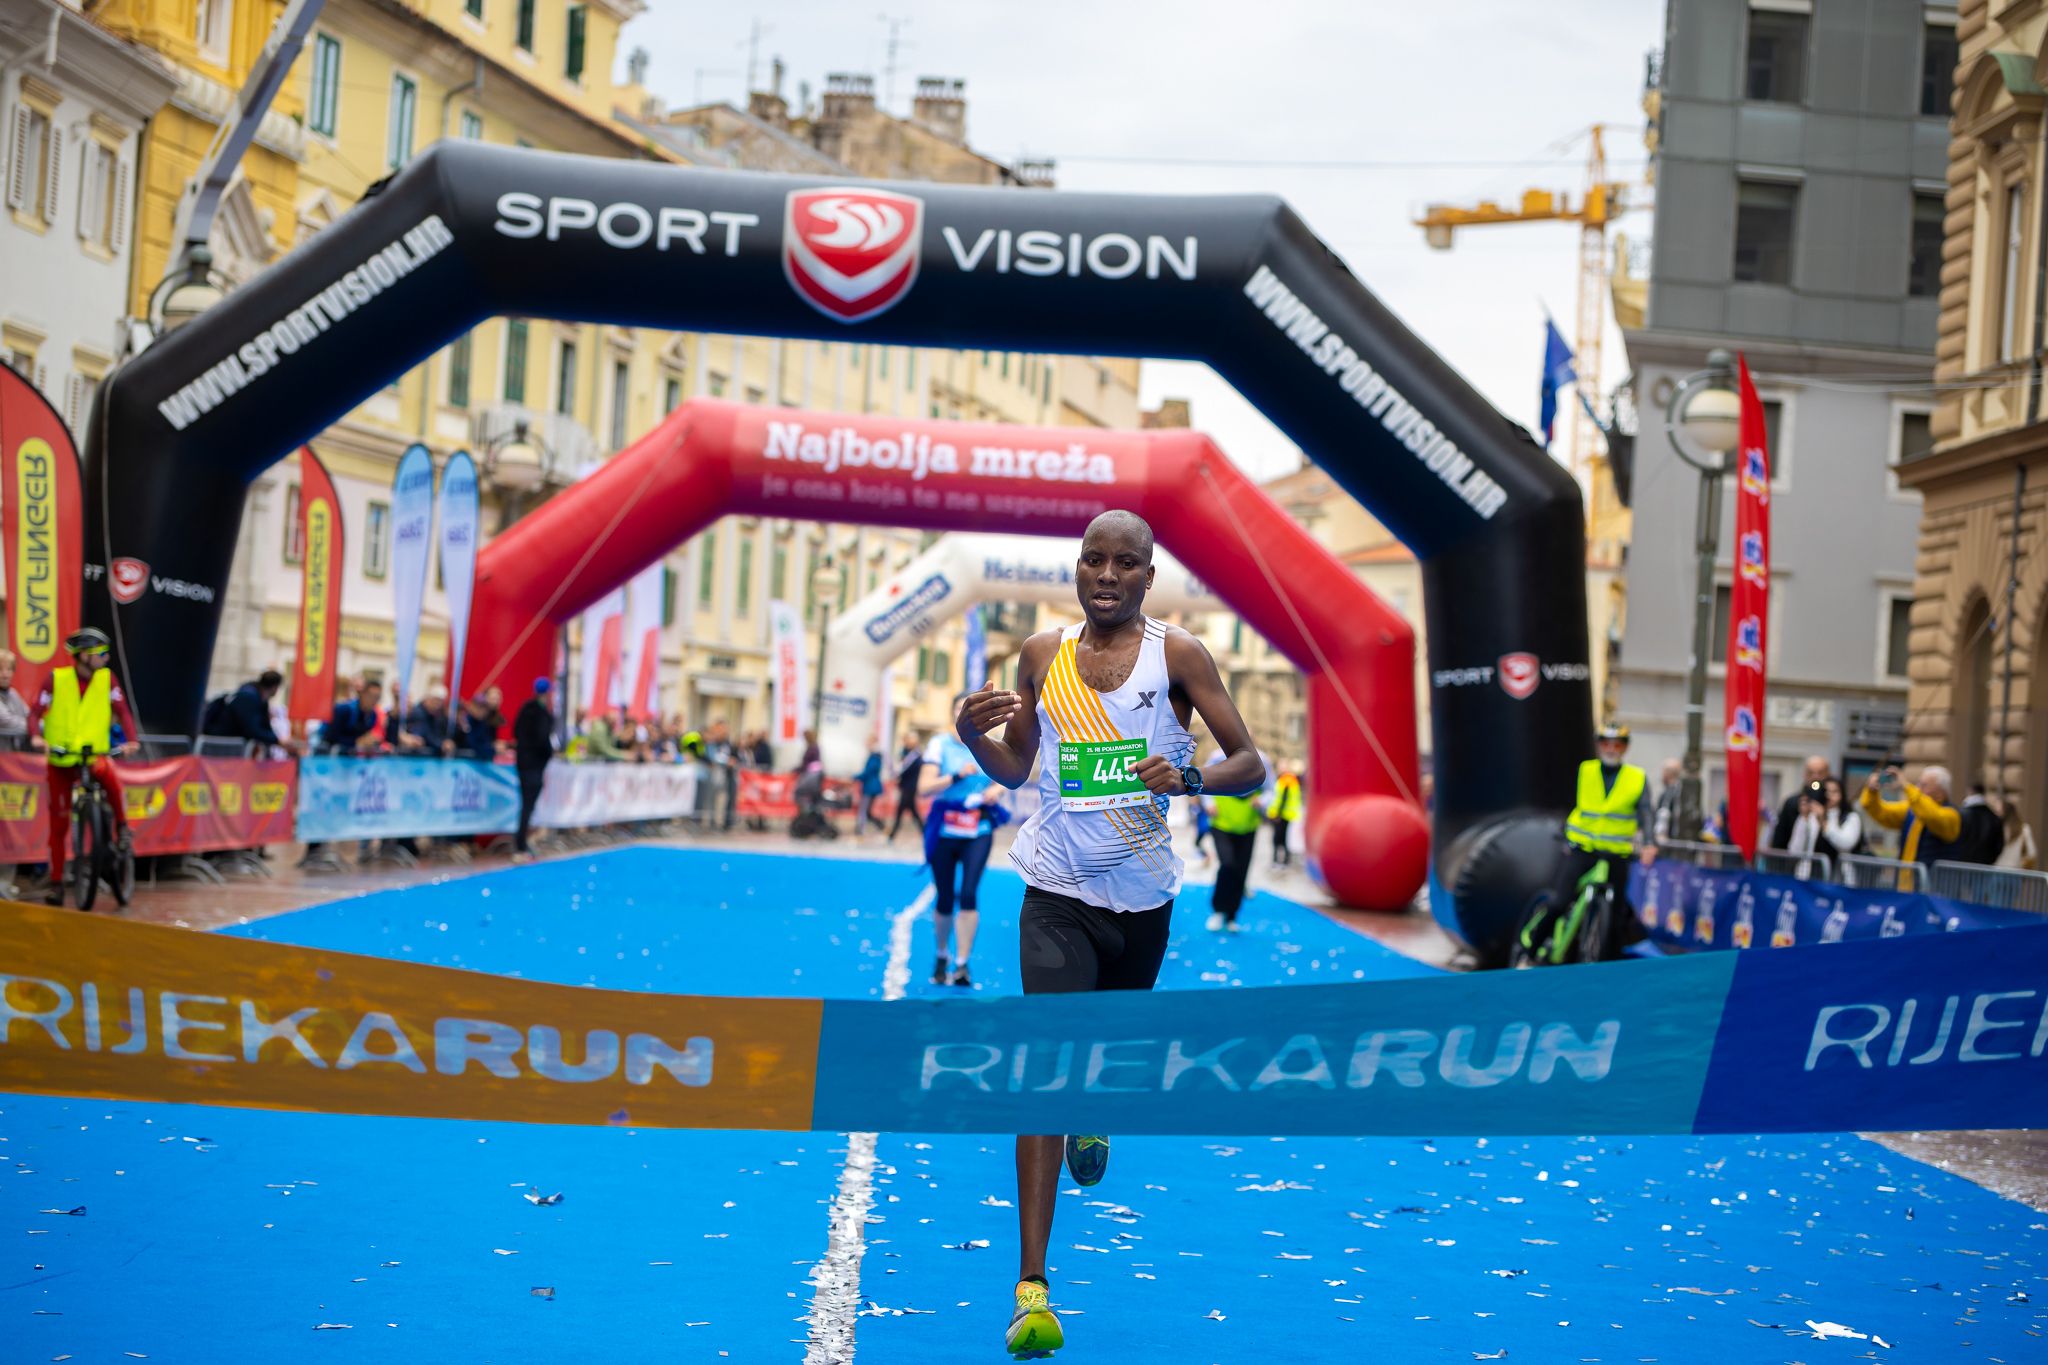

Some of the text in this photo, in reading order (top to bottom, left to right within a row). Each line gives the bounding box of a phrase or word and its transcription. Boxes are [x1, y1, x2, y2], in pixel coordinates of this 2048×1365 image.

[494, 192, 1198, 280] SPORT VISION
[157, 214, 454, 431] WWW.SPORTVISION.HR
[1243, 264, 1508, 520] WWW.SPORTVISION.HR
[763, 421, 1116, 484] Najbolja mreža
[151, 575, 215, 603] VISION
[1061, 753, 1078, 762] RUN
[1093, 756, 1138, 784] 445
[0, 974, 714, 1088] RIJEKARUN
[920, 1020, 1620, 1093] RIJEKARUN
